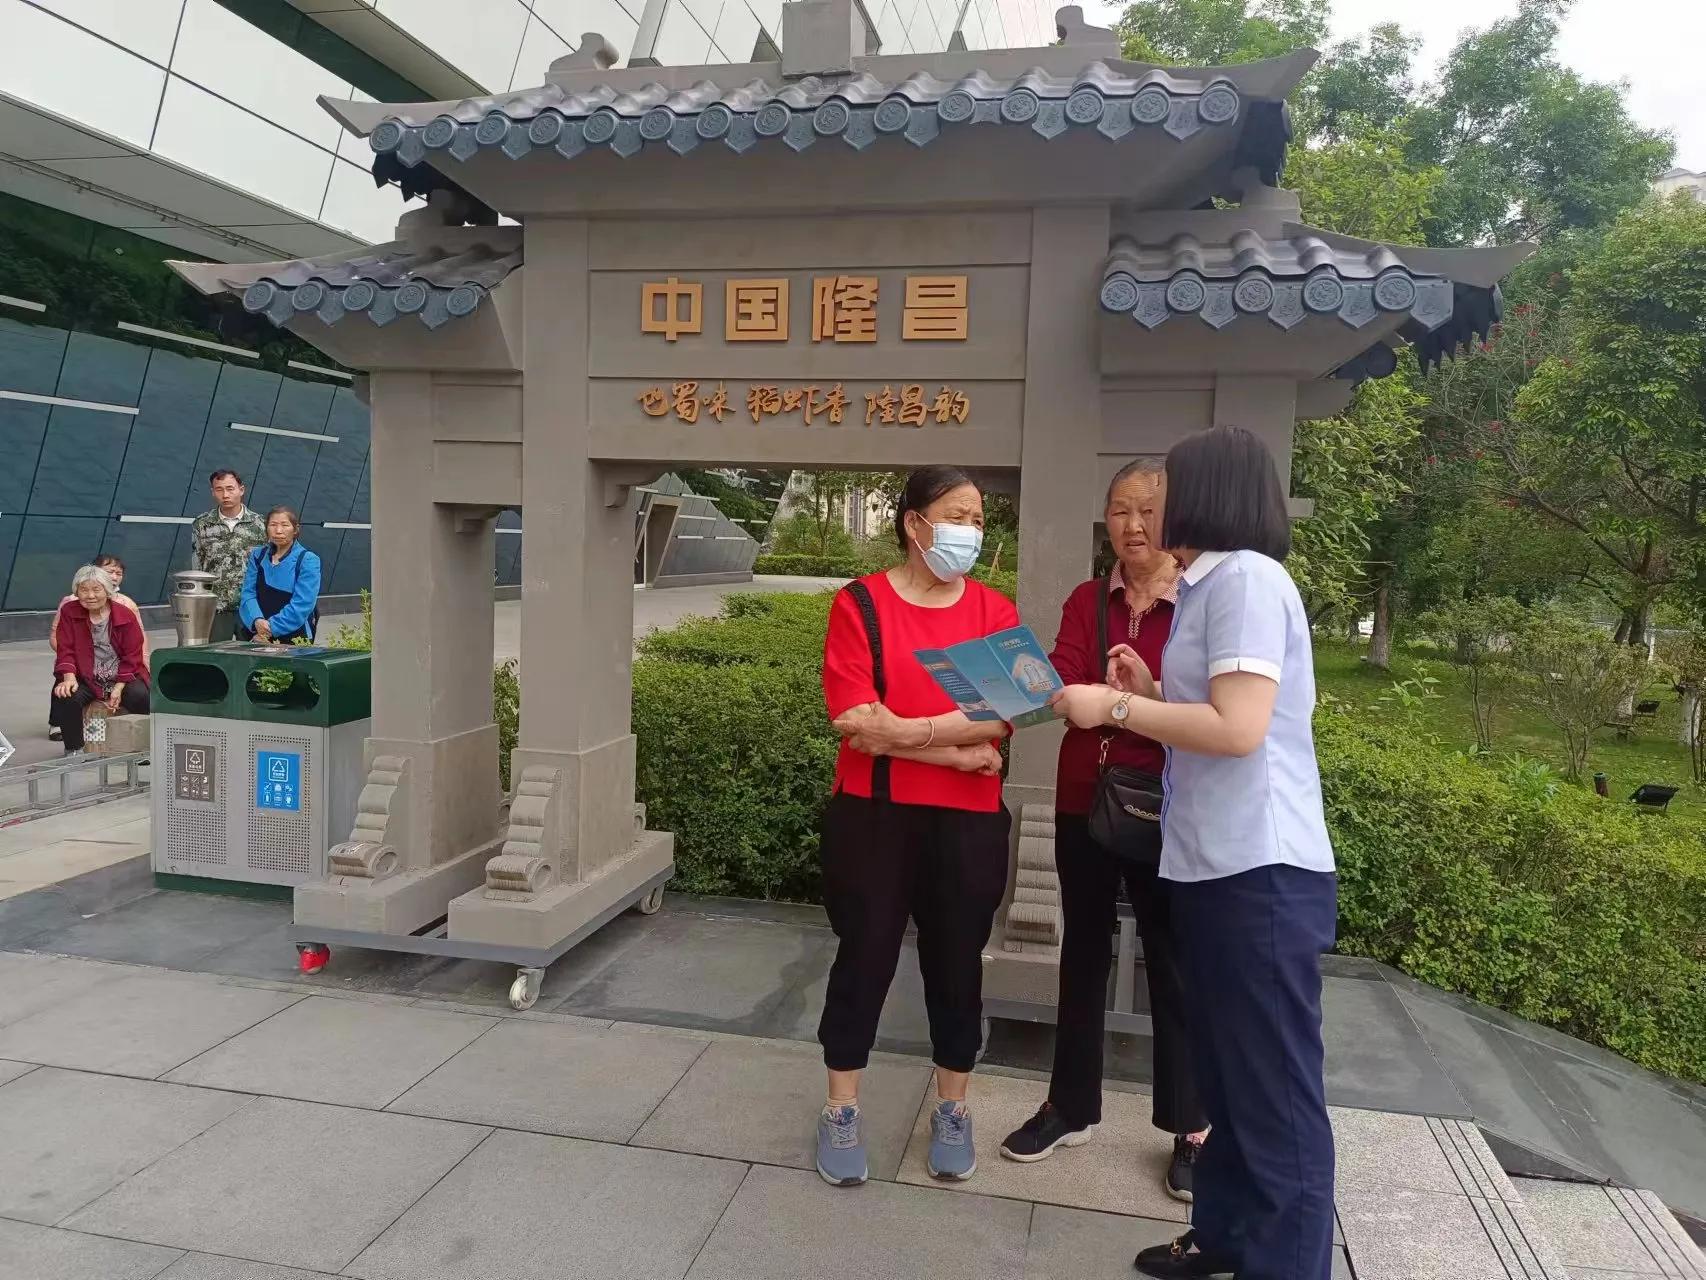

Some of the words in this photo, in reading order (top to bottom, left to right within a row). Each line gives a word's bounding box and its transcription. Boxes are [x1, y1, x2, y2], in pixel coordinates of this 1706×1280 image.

[641, 276, 968, 342] 中国隆昌
[637, 381, 735, 425] 巴蜀味
[746, 383, 849, 428] 稻虾香
[864, 383, 970, 428] 隆昌韵
